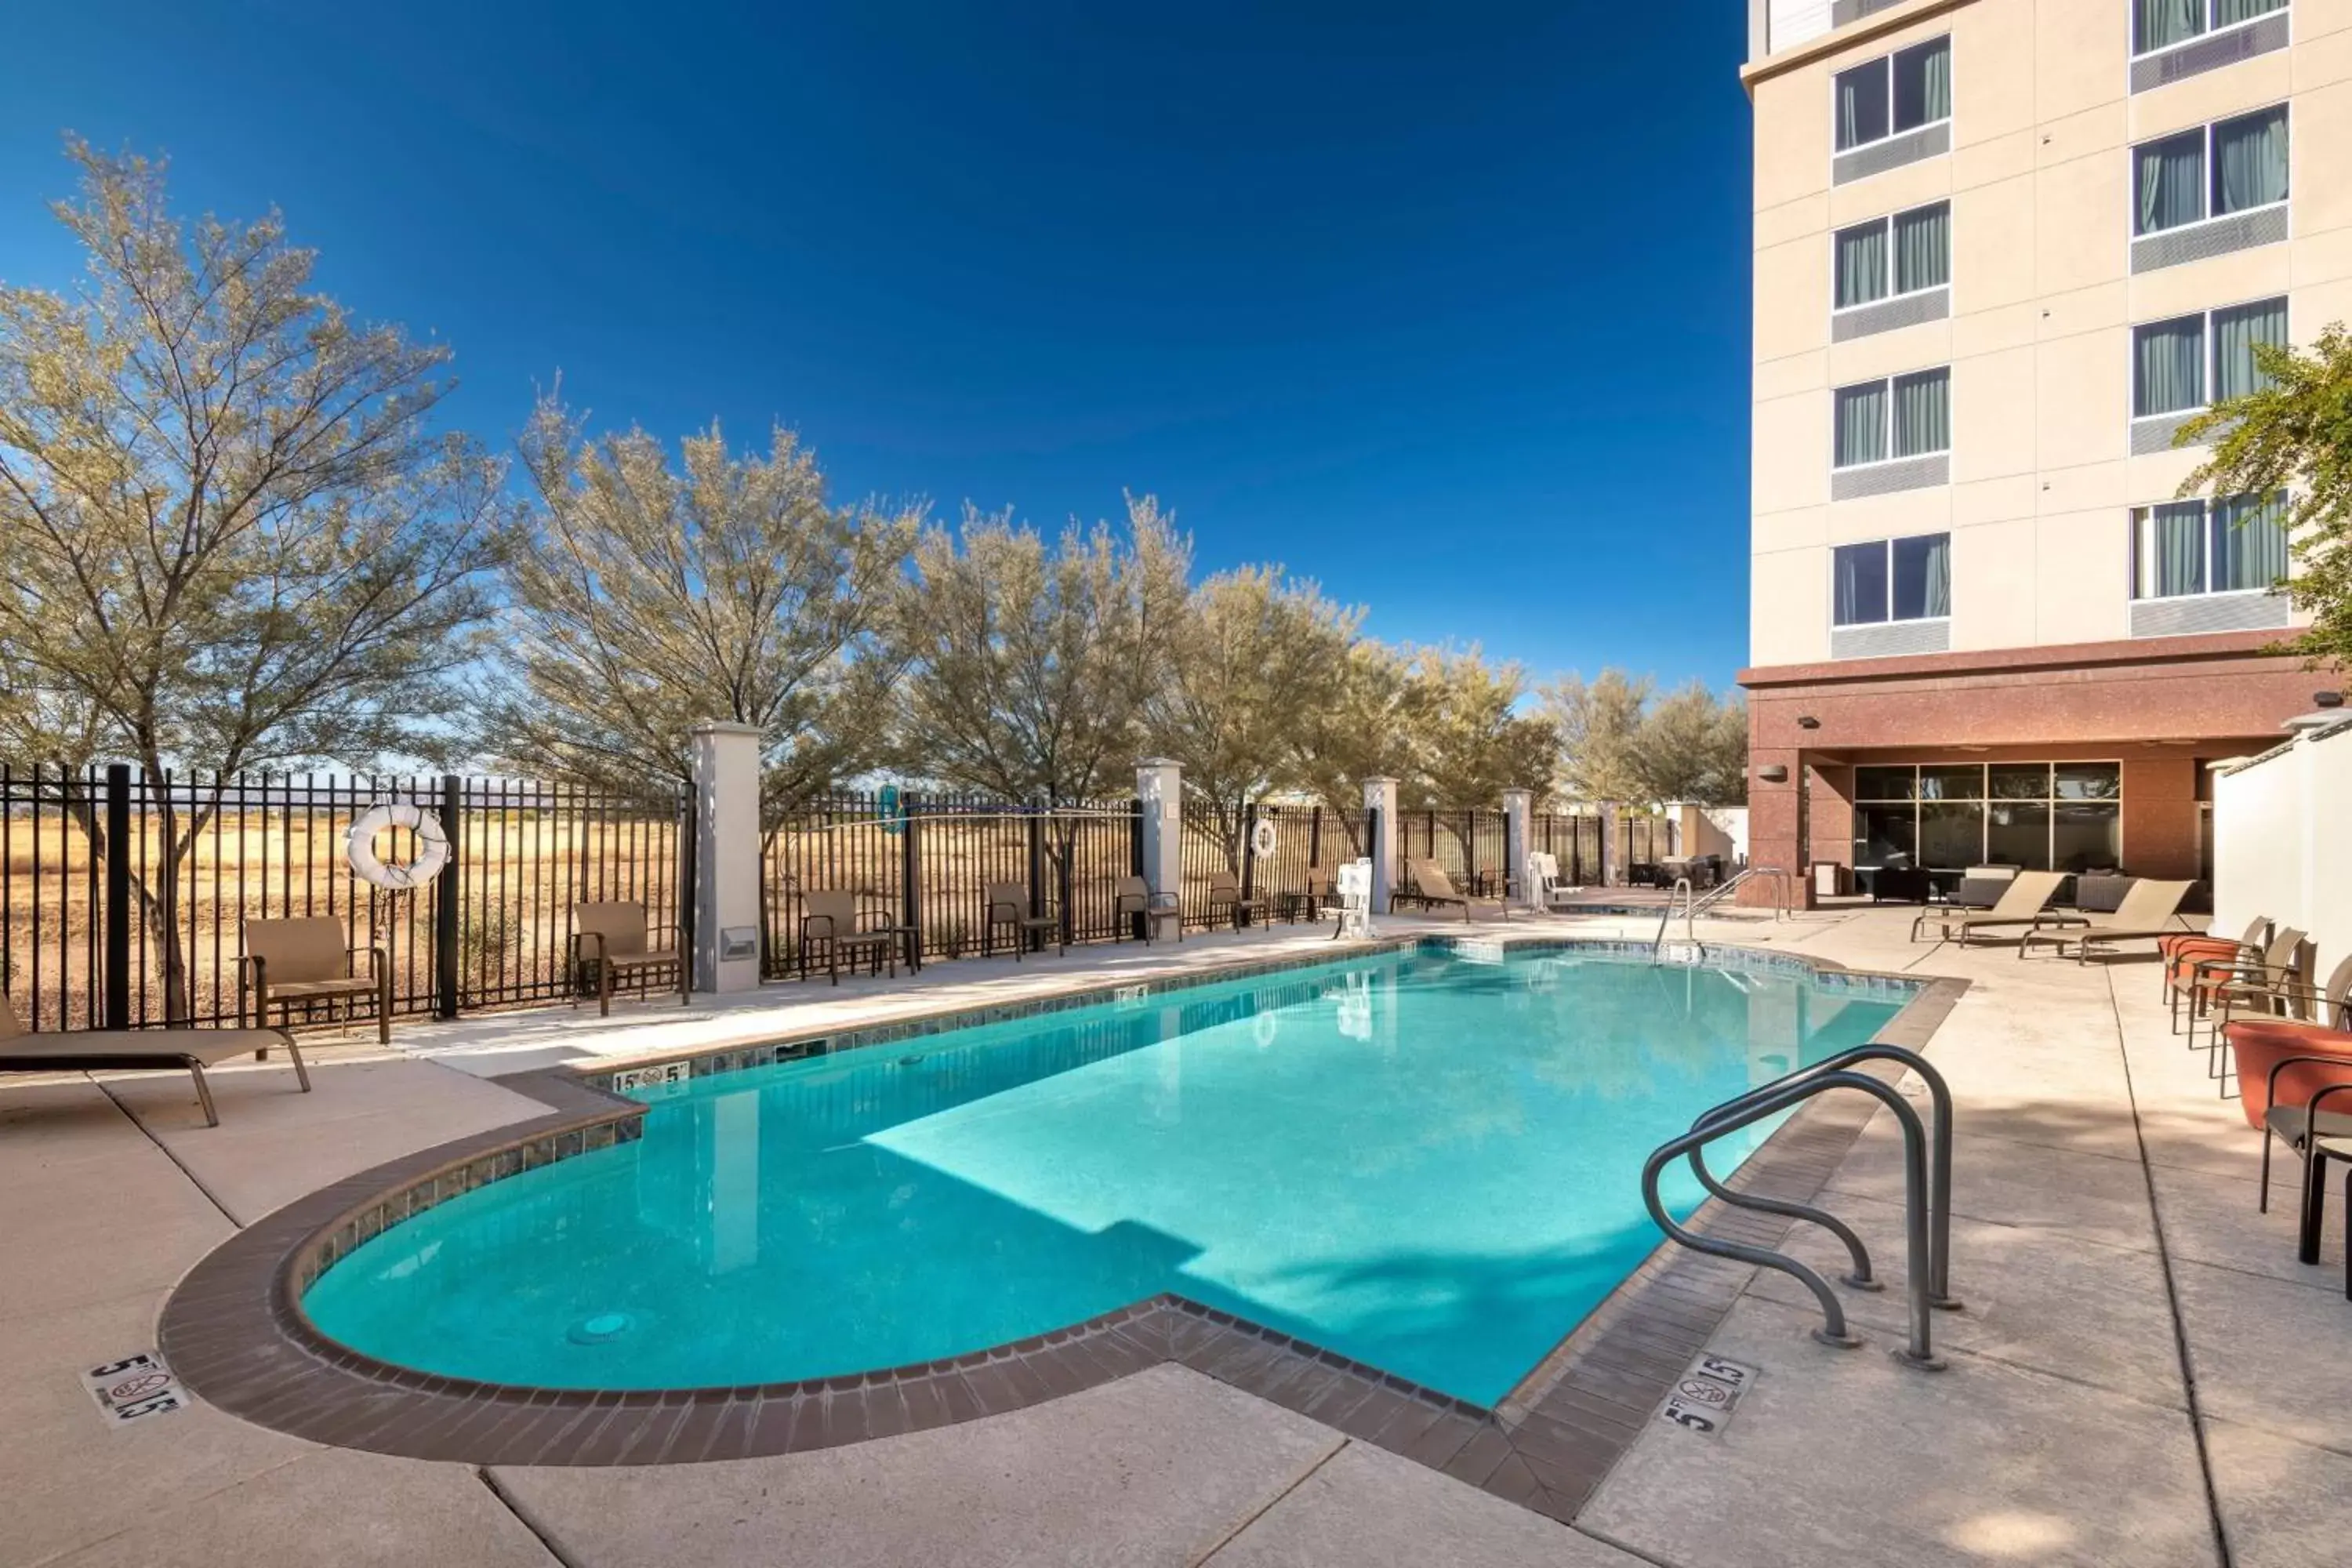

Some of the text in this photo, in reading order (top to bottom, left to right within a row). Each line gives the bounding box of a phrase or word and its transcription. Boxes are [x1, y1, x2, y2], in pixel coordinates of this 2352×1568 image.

[667, 1065, 678, 1083] 5
[91, 1355, 149, 1377] 5
[1665, 1407, 1715, 1432] 5
